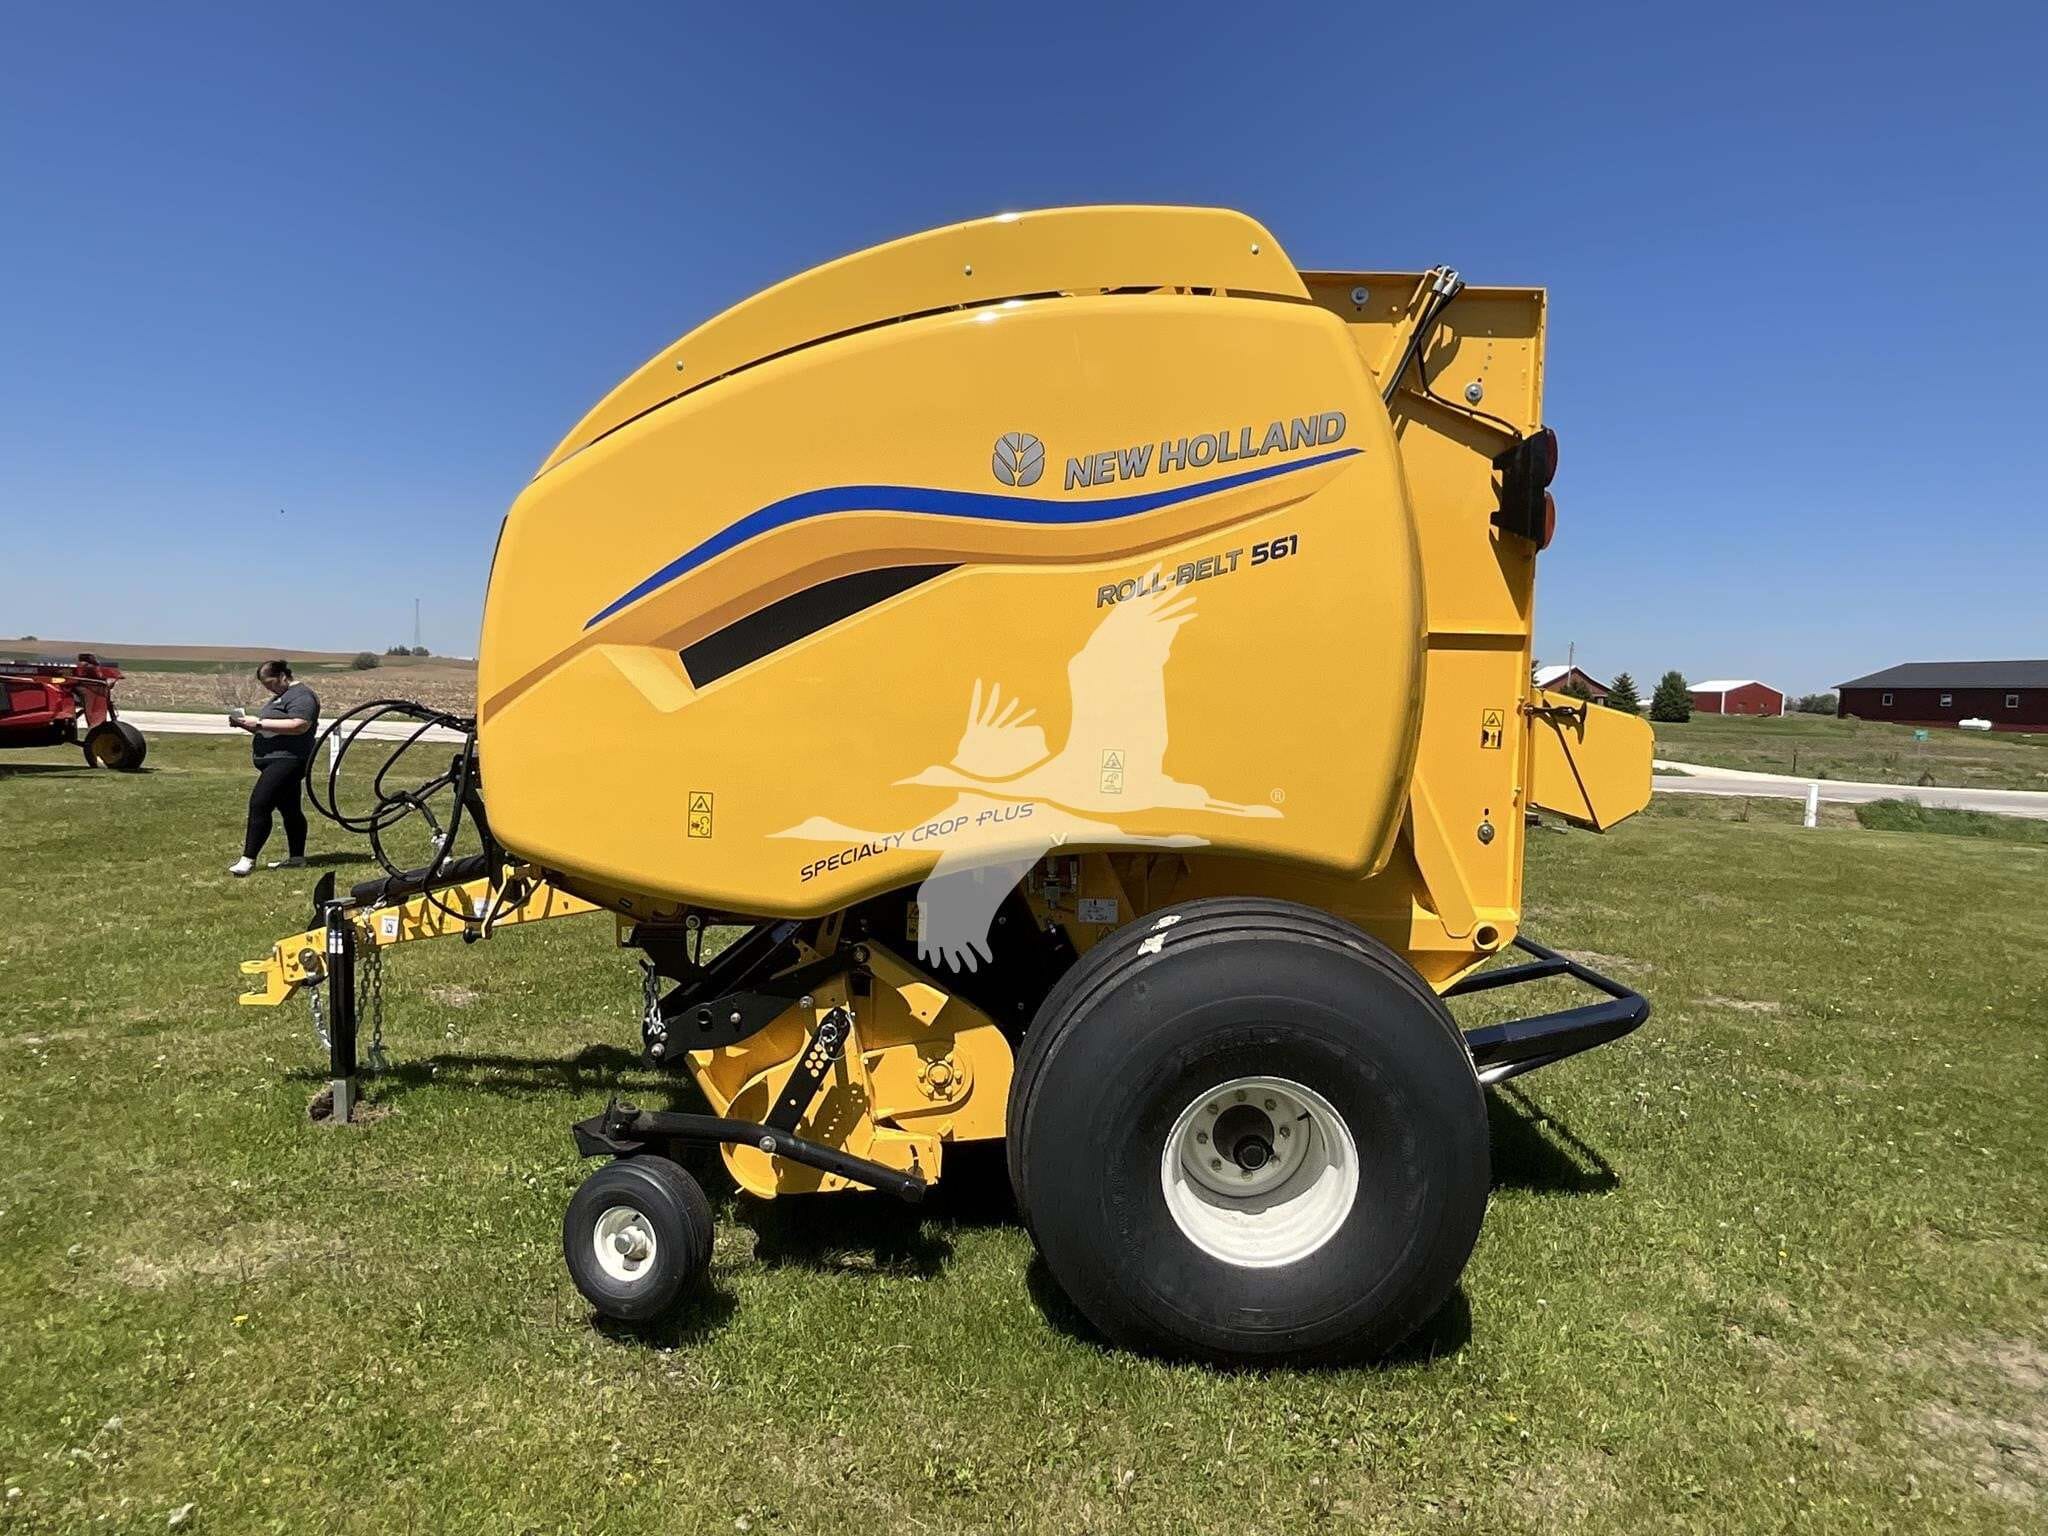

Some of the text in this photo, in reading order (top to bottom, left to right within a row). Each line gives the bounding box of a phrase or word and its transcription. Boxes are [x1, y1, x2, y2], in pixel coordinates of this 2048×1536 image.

[1064, 411, 1346, 490] NEW HOLLAND
[1097, 534, 1298, 608] ROLL-BELT 561
[801, 803, 1034, 882] SPECIALTY CROP PLUS
